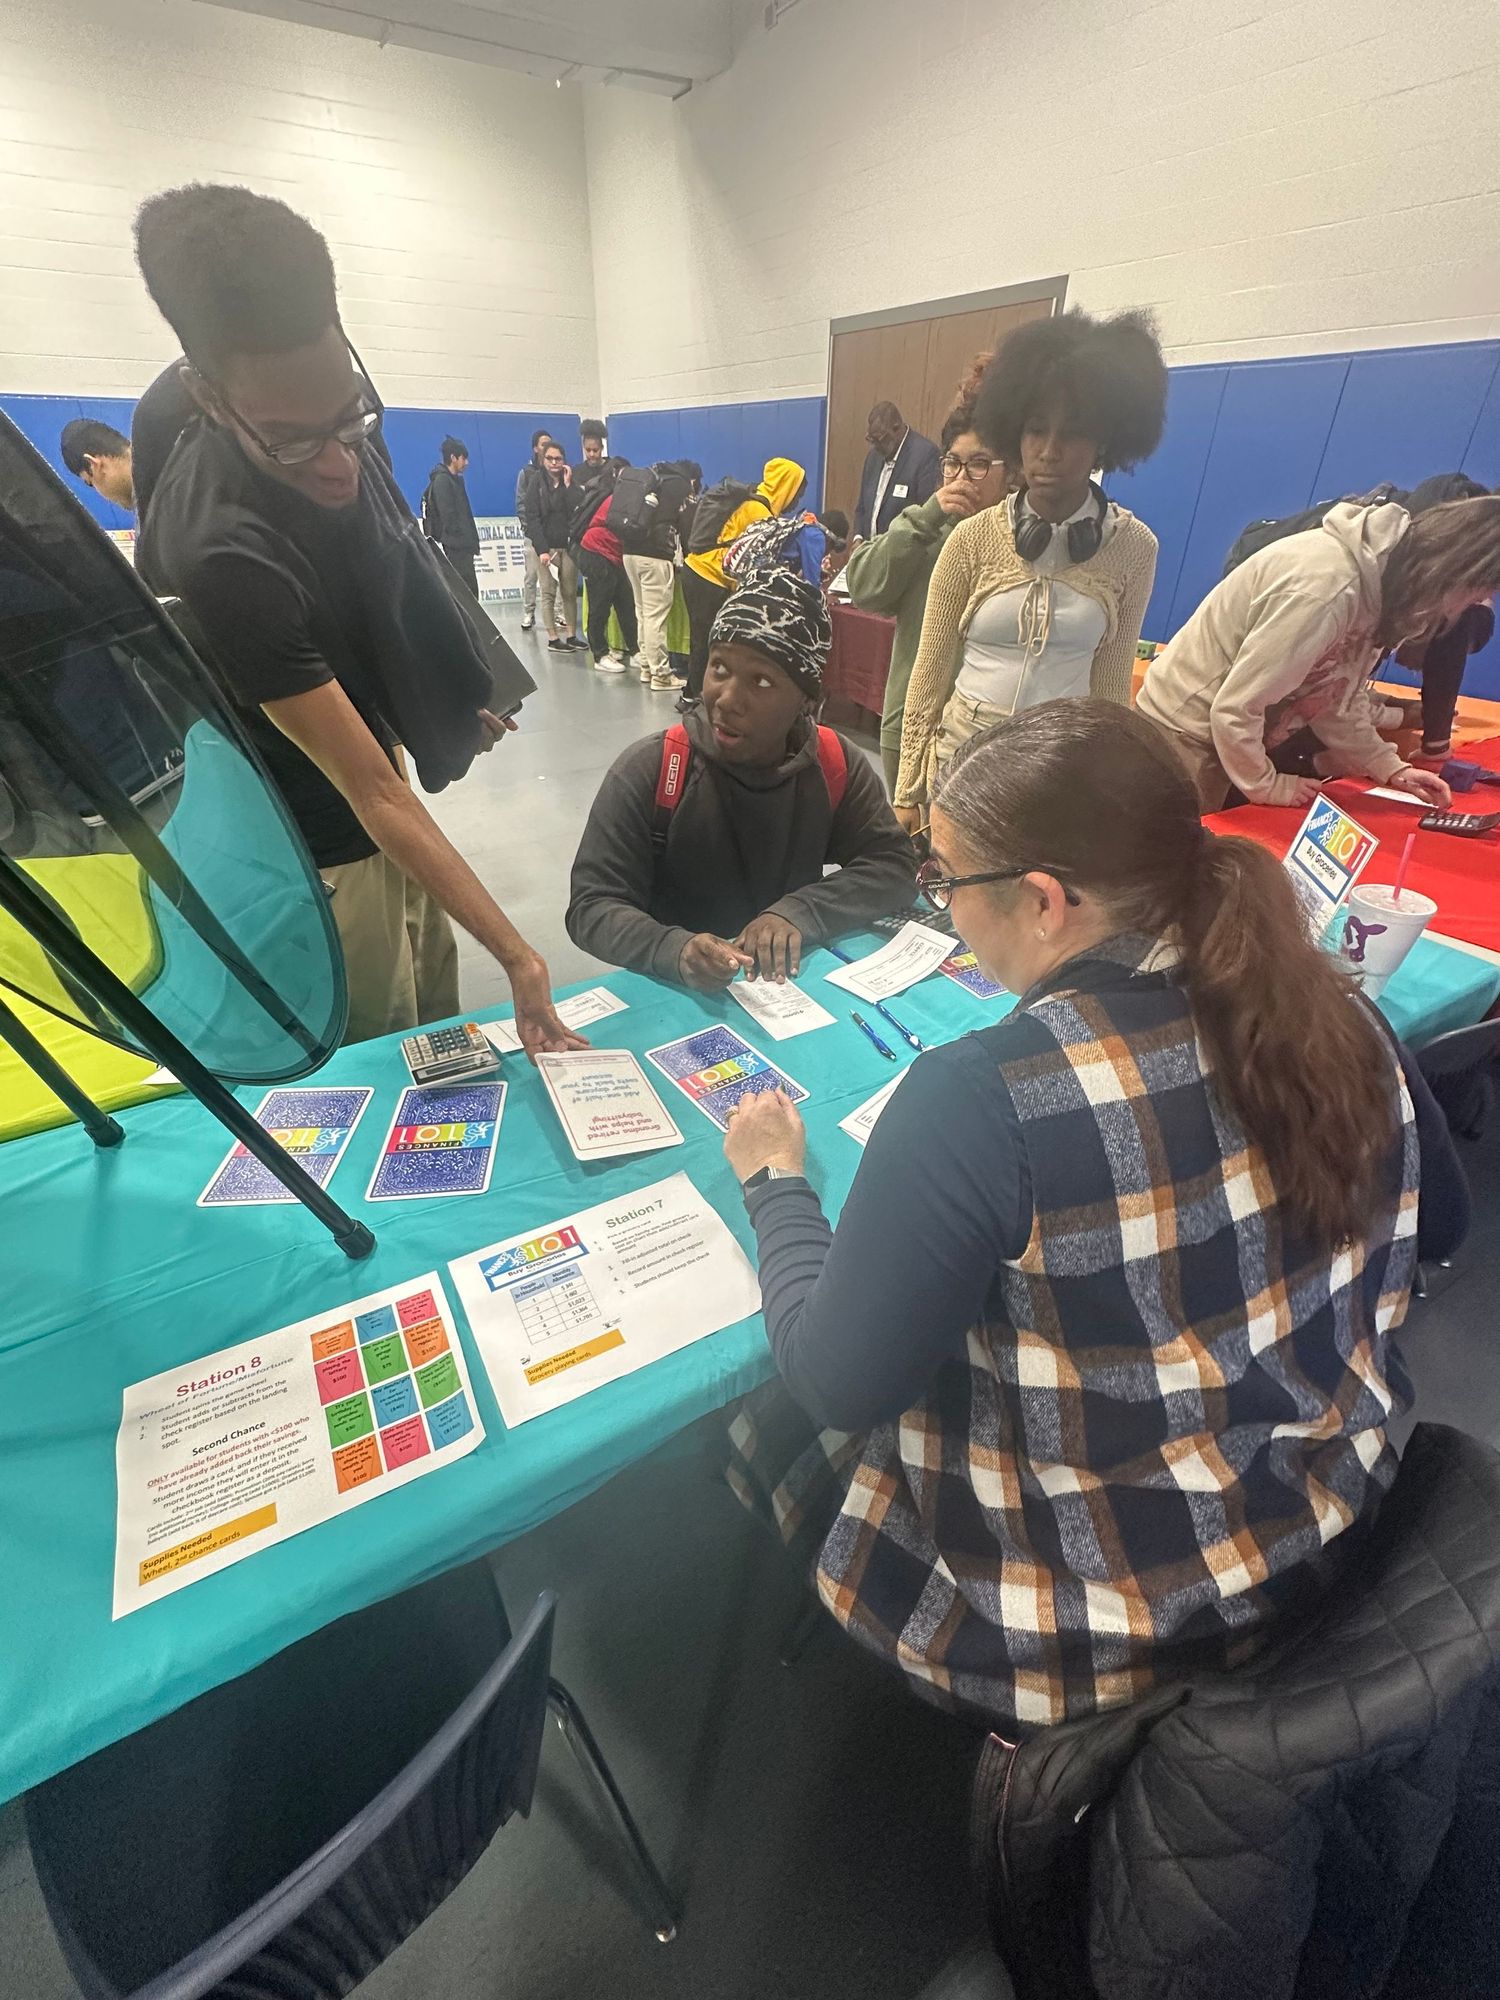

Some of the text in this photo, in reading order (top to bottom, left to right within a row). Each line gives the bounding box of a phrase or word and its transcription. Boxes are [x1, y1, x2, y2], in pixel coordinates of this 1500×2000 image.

[1306, 845, 1316, 860] Buy
[1315, 854, 1338, 880] Groceries
[697, 1071, 748, 1096] FINANCES
[397, 1141, 460, 1151] FINANCES
[587, 1124, 660, 1140] Grandma retired
[606, 1199, 662, 1227] Station 7
[507, 1268, 523, 1276] Buy
[525, 1250, 566, 1269] Groceries
[176, 1356, 261, 1396] Station 8
[527, 1350, 575, 1375] Supplies Needed
[530, 1352, 591, 1381] Grocery playing cards
[140, 1402, 174, 1419] Wheel
[161, 1408, 190, 1422] Student
[192, 1401, 210, 1410] spins
[225, 1387, 244, 1398] game
[246, 1377, 266, 1389] wheel
[161, 1416, 189, 1431] Student
[192, 1409, 209, 1418] adds
[222, 1392, 254, 1407] subtracts
[256, 1384, 272, 1393] from
[161, 1428, 182, 1439] check
[184, 1416, 212, 1430] register
[214, 1406, 235, 1418] based
[248, 1397, 260, 1405] the
[262, 1387, 287, 1399] landing
[147, 1416, 309, 1488] ONLY available for students with <$100 who
[161, 1438, 180, 1449] spot.
[192, 1421, 265, 1456] Second Chance
[153, 1487, 183, 1504] Student
[185, 1477, 208, 1490] draws
[217, 1466, 234, 1477] card,
[237, 1459, 251, 1469] and
[259, 1449, 275, 1459] they
[277, 1435, 307, 1451] received
[158, 1429, 300, 1491] have already added back their savings.
[163, 1496, 184, 1508] more
[186, 1484, 214, 1498] income
[216, 1475, 233, 1486] they
[235, 1468, 248, 1478] will
[249, 1460, 269, 1472] enter
[286, 1448, 298, 1456] the
[172, 1492, 213, 1513] checkbook
[215, 1479, 244, 1494] register
[262, 1459, 291, 1475] deposit.
[143, 1533, 212, 1570] Supplies Needed
[143, 1562, 172, 1581] Wheel,
[188, 1541, 217, 1558] chance
[219, 1531, 240, 1544] cards
